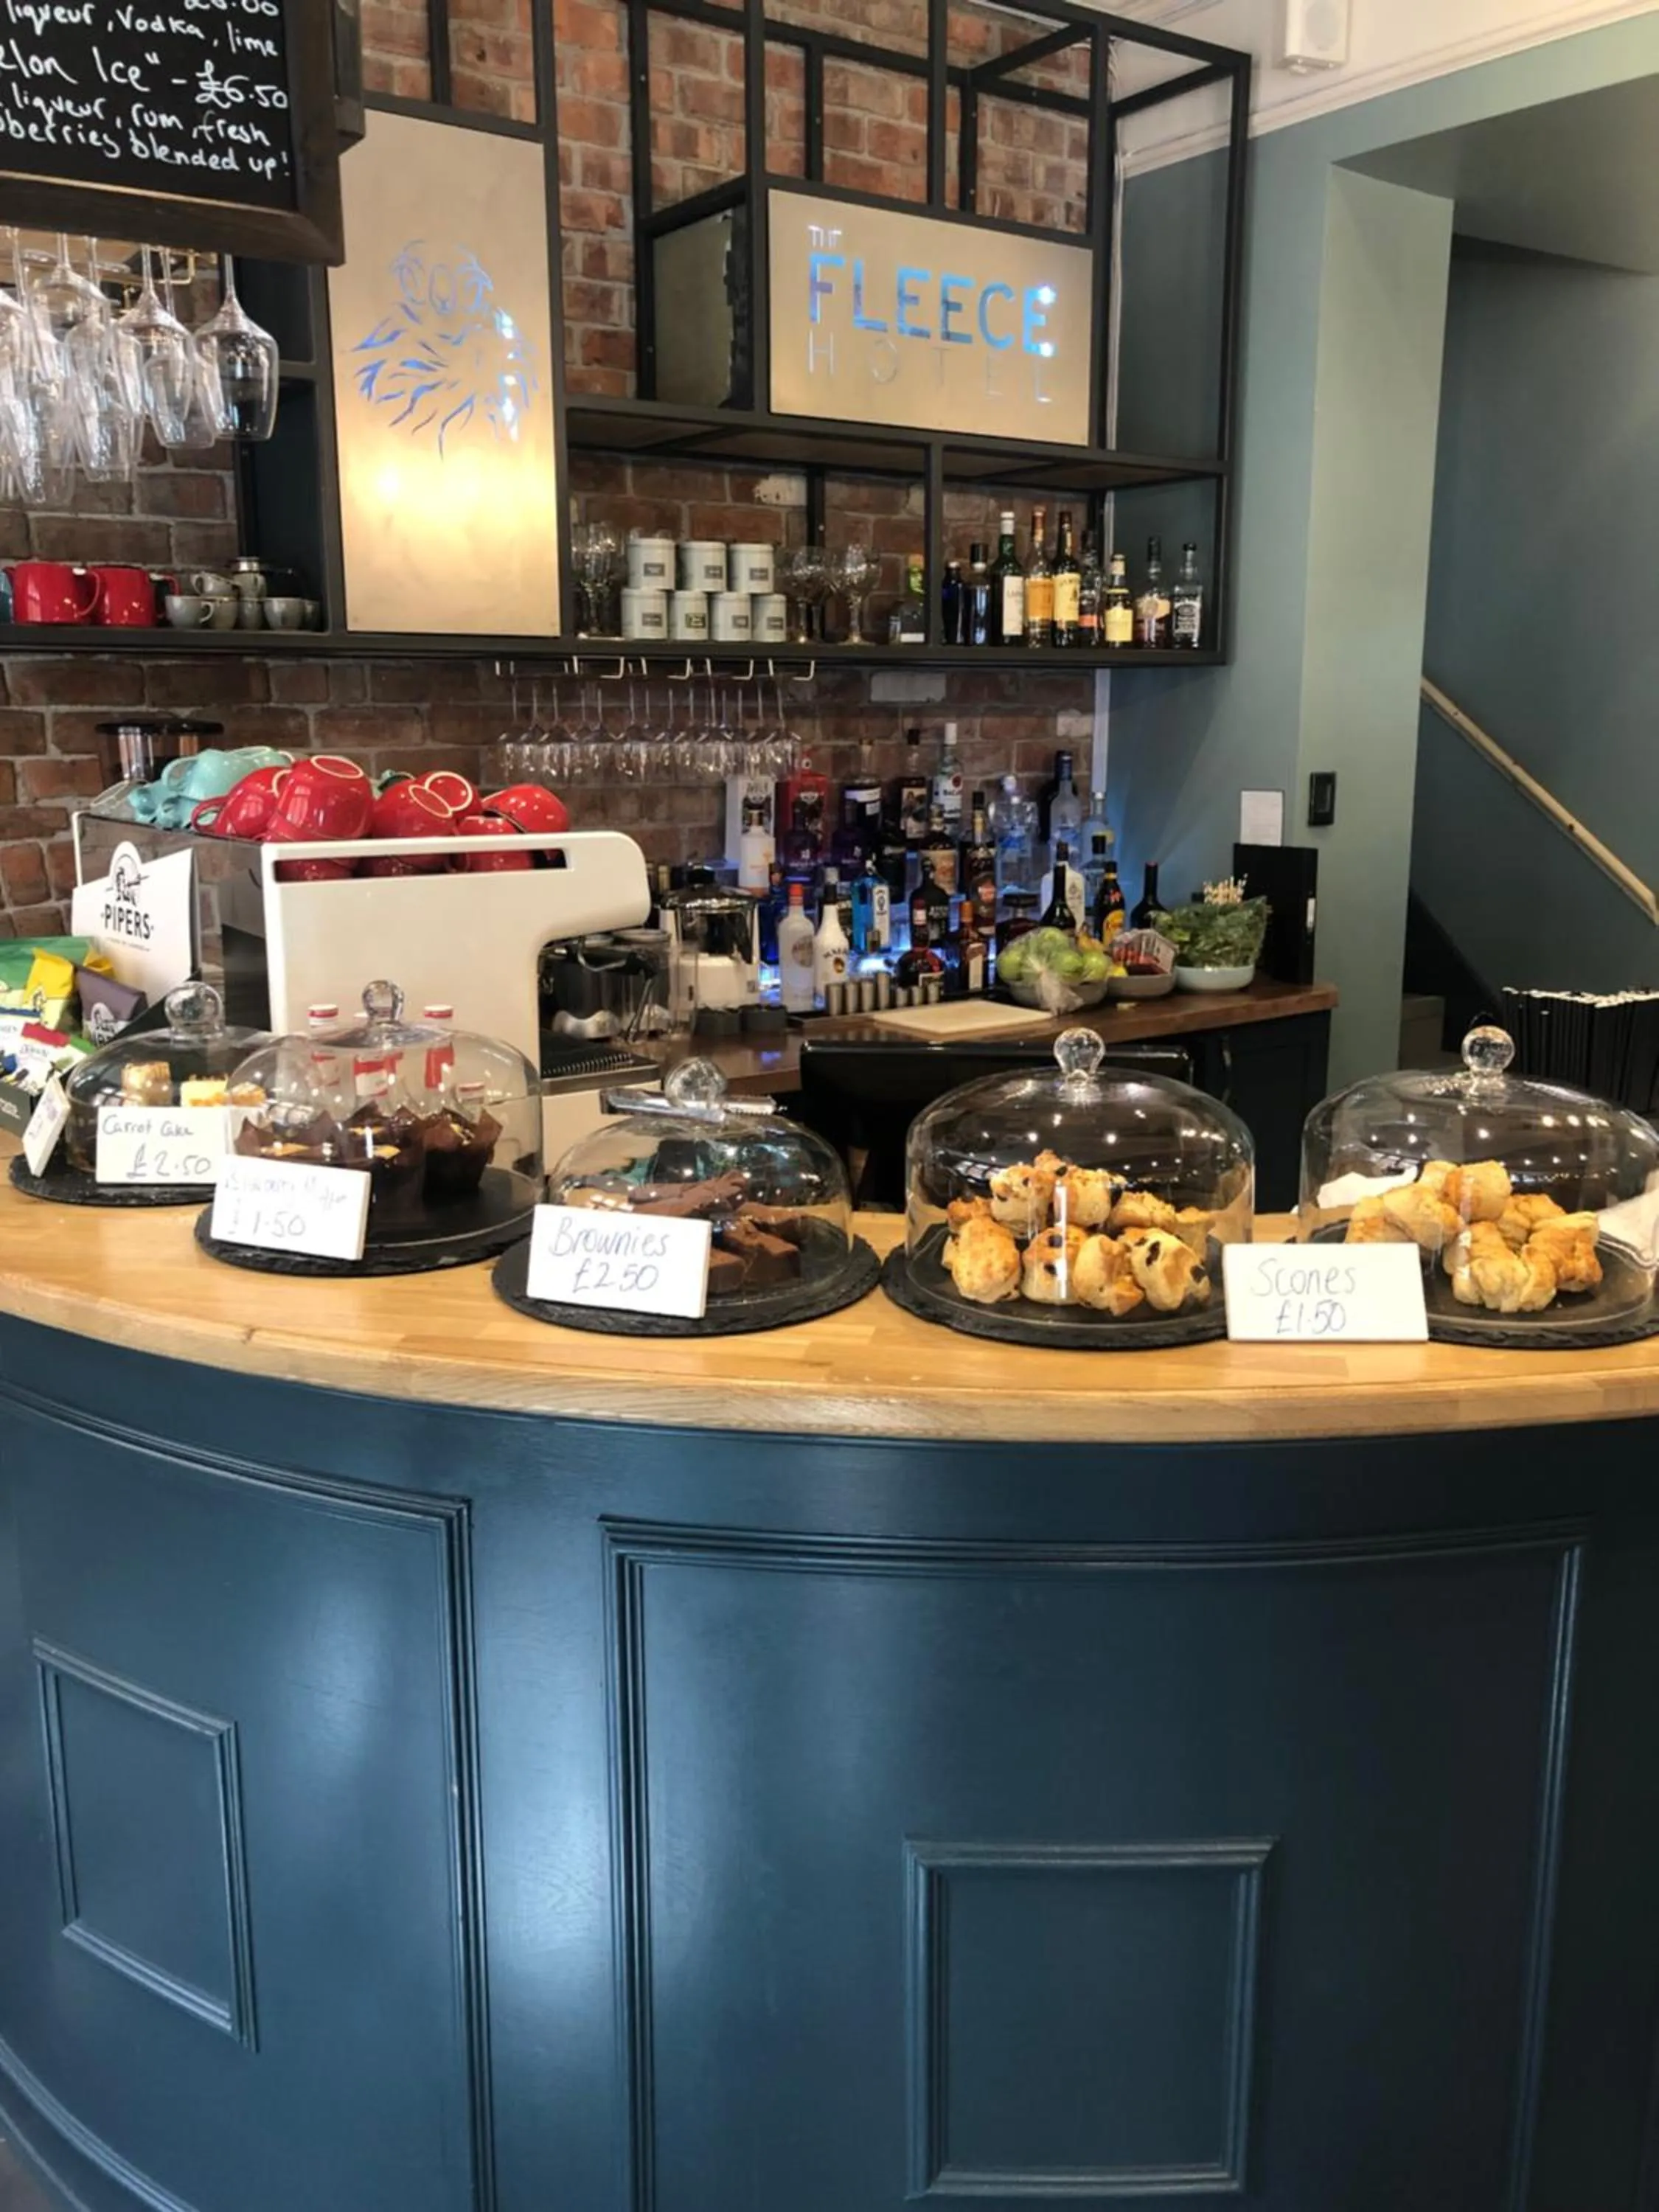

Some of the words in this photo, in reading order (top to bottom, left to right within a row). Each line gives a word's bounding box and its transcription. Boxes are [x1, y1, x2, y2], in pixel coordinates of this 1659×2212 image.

[226, 21, 279, 57] lime
[195, 59, 288, 108] £6.50
[0, 108, 121, 159] berries
[128, 128, 240, 170] blended
[248, 151, 290, 180] up!
[808, 251, 1057, 357] FLEECE
[808, 327, 1053, 403] HOTEL
[104, 903, 151, 940] PIPERS
[102, 1113, 153, 1135] Carrot
[160, 1120, 194, 1137] Cake
[548, 1216, 670, 1256] Brownies
[1251, 1257, 1356, 1297] Scones
[1276, 1298, 1346, 1335] £1.50
